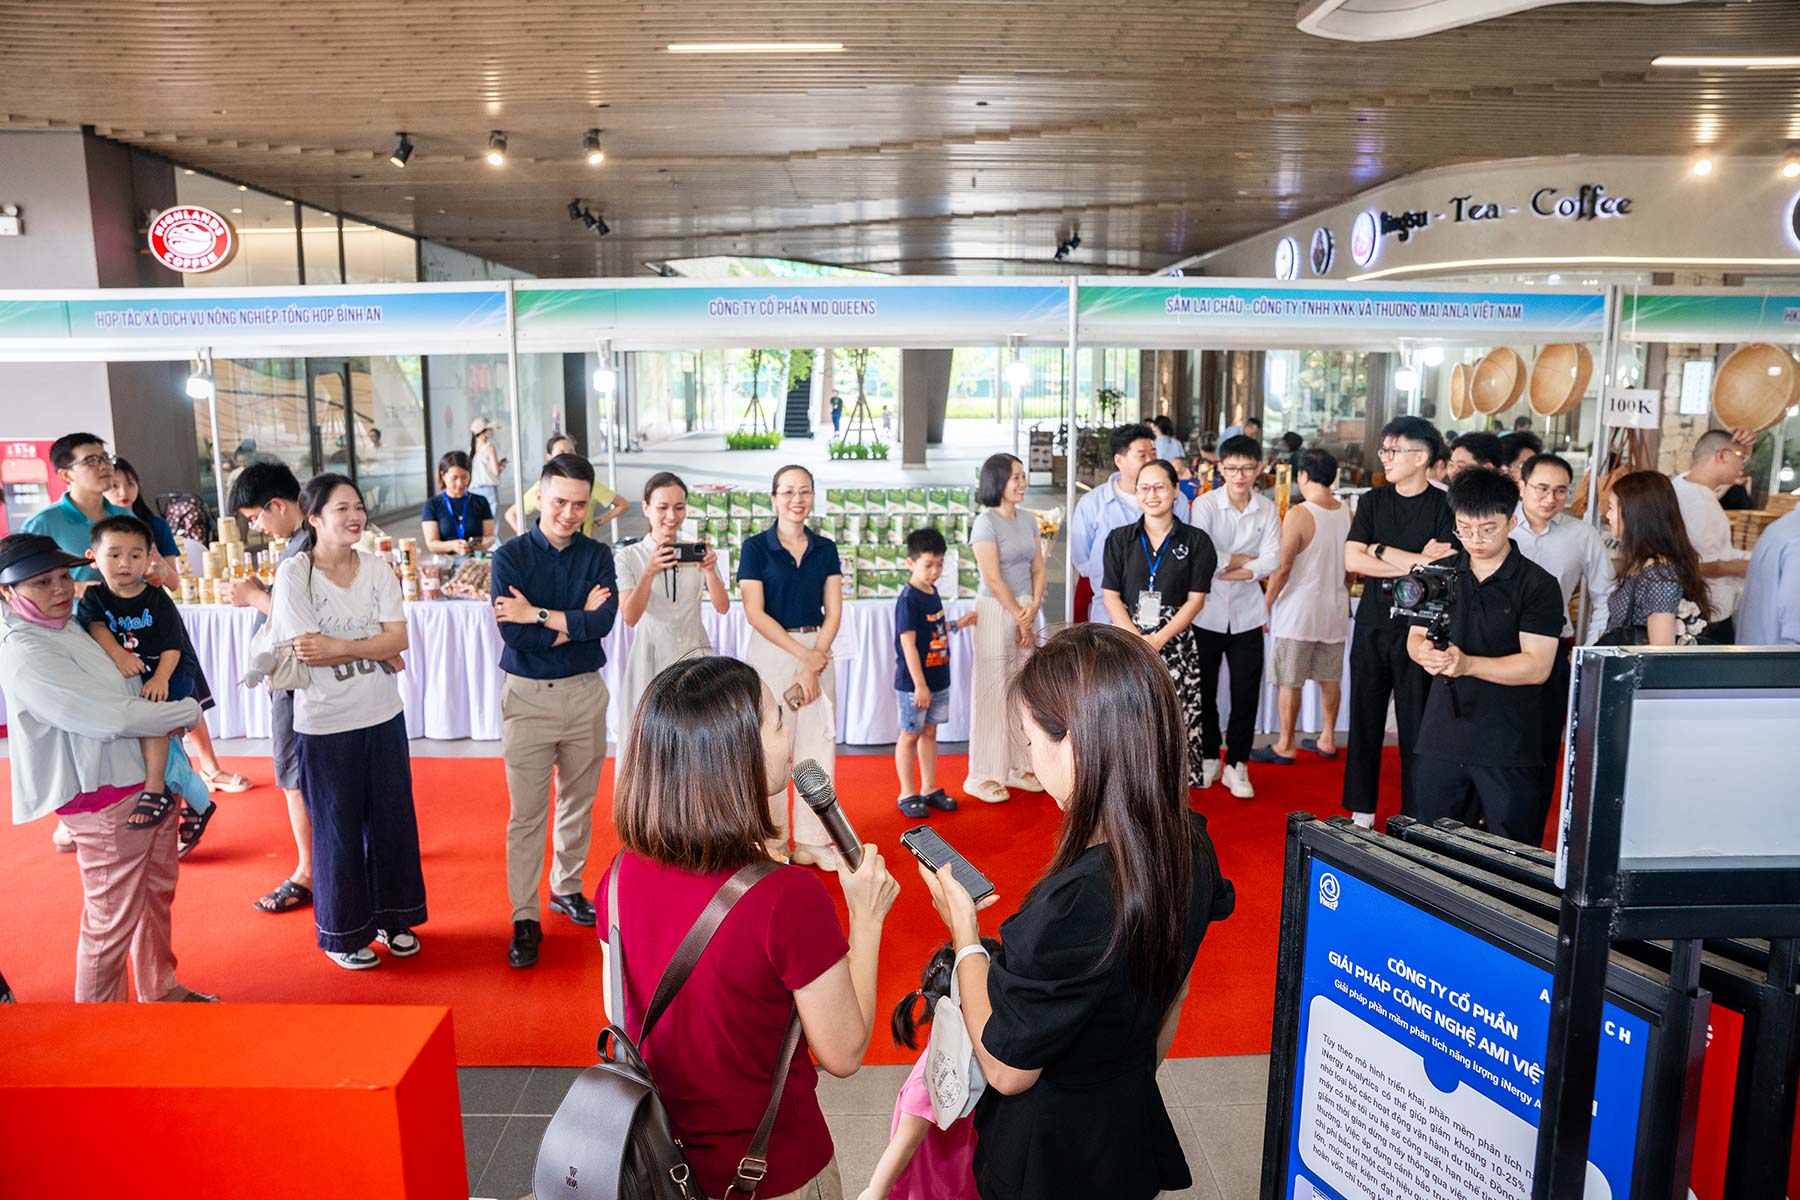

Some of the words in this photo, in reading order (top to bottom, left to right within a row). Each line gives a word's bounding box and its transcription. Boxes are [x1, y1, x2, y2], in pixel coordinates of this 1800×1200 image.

[154, 209, 225, 237] HIGHLANDS
[1449, 195, 1501, 223] Tea
[1531, 184, 1633, 221] Coffee
[164, 252, 218, 269] COFFEE
[207, 307, 237, 326] NÔNG
[366, 307, 381, 321] AN
[709, 297, 740, 315] CÔNG
[743, 301, 757, 315] TY
[811, 301, 829, 315] MD
[831, 300, 876, 315] QUEENS
[1193, 299, 1211, 313] LAI
[1213, 297, 1243, 314] CHÂU
[1253, 298, 1282, 314] CÔNG
[1285, 300, 1299, 314] TY
[1301, 300, 1330, 315] TNHH
[1333, 301, 1355, 316] XNK
[1358, 299, 1372, 317] VÀ
[1442, 303, 1469, 318] ANLA
[1471, 301, 1494, 319] VIỆT
[1498, 304, 1522, 319] NAM
[1610, 398, 1653, 414] 100K
[1328, 950, 1353, 975] GIẢI
[1355, 965, 1391, 993] PHÁP
[1392, 988, 1432, 1020] CÔNG
[1434, 1010, 1477, 1047] NGHỆ
[1477, 1037, 1509, 1065] AMI
[1512, 1053, 1545, 1085] VIỆ
[1387, 957, 1427, 989] CÔNG
[1428, 978, 1448, 999] TY
[1448, 991, 1471, 1012] CỔ
[1472, 1003, 1518, 1040] PHẦN
[1334, 979, 1348, 994] Giải
[1349, 990, 1367, 1006] pháp
[1368, 1000, 1388, 1017] phần
[1388, 1013, 1409, 1030] mềm
[1409, 1025, 1430, 1043] phân
[1431, 1036, 1448, 1053] tích
[1449, 1049, 1471, 1069] năng
[1472, 1062, 1499, 1086] lượng
[1500, 1077, 1532, 1105] iNergy
[1317, 1091, 1335, 1107] giảm
[1336, 1103, 1350, 1118] thời
[1350, 1115, 1367, 1131] gian
[1367, 1127, 1388, 1147] dừng
[1388, 1142, 1405, 1159] máy
[1407, 1154, 1430, 1178] thông
[1431, 1173, 1448, 1190] qua
[1319, 1077, 1334, 1093] máy
[1334, 1087, 1344, 1099] có
[1344, 1093, 1357, 1108] thể
[1357, 1103, 1368, 1116] tối
[1368, 1112, 1379, 1124] ưu
[1380, 1118, 1390, 1133] hệ
[1390, 1128, 1401, 1139] số
[1401, 1135, 1422, 1156] công
[1423, 1151, 1444, 1171] suất,
[1445, 1164, 1462, 1183] hạn
[1463, 1179, 1480, 1196] chế
[1320, 1062, 1334, 1077] nhờ
[1334, 1071, 1347, 1086] loại
[1348, 1080, 1358, 1093] bỏ
[1358, 1090, 1372, 1103] các
[1373, 1098, 1390, 1117] hoạt
[1391, 1112, 1412, 1132] động
[1412, 1127, 1427, 1142] vận
[1429, 1136, 1449, 1157] hành
[1451, 1153, 1463, 1166] dư
[1464, 1162, 1487, 1184] thừa.
[1321, 1047, 1344, 1070] iNergy
[1346, 1065, 1379, 1093] Analytics
[1381, 1090, 1392, 1101] có
[1393, 1096, 1408, 1111] thể
[1409, 1108, 1427, 1126] giúp
[1429, 1122, 1451, 1142] giảm
[1454, 1136, 1487, 1168] khoảng
[1491, 1162, 1526, 1193] 10-25%
[1322, 1033, 1336, 1049] Tùy
[1337, 1043, 1353, 1060] theo
[1354, 1056, 1367, 1069] mô
[1369, 1063, 1386, 1081] hình
[1387, 1077, 1405, 1094] triển
[1407, 1089, 1426, 1110] khai,
[1429, 1105, 1450, 1124] phần
[1452, 1121, 1475, 1141] mềm
[1477, 1137, 1501, 1158] phân
[1504, 1154, 1522, 1172] tích
[1313, 1144, 1330, 1163] hoàn
[1330, 1159, 1344, 1174] vốn
[1344, 1170, 1356, 1183] chỉ
[1356, 1179, 1376, 1200] trong
[1315, 1118, 1326, 1128] chi
[1326, 1126, 1338, 1139] phí
[1338, 1134, 1351, 1150] bảo
[1352, 1145, 1360, 1157] trì
[1361, 1153, 1376, 1169] một
[1376, 1165, 1395, 1183] cách
[1395, 1177, 1413, 1197] hiệu
[1316, 1103, 1342, 1128] thường.
[1344, 1123, 1360, 1141] Việc
[1361, 1137, 1371, 1150] áp
[1373, 1145, 1392, 1166] dụng
[1393, 1161, 1413, 1181] cảnh
[1415, 1175, 1431, 1193] báo
[1328, 1143, 1344, 1159] mức
[1346, 1155, 1359, 1171] tiết
[1360, 1165, 1379, 1186] kiệm
[1380, 1182, 1394, 1198] đạt
